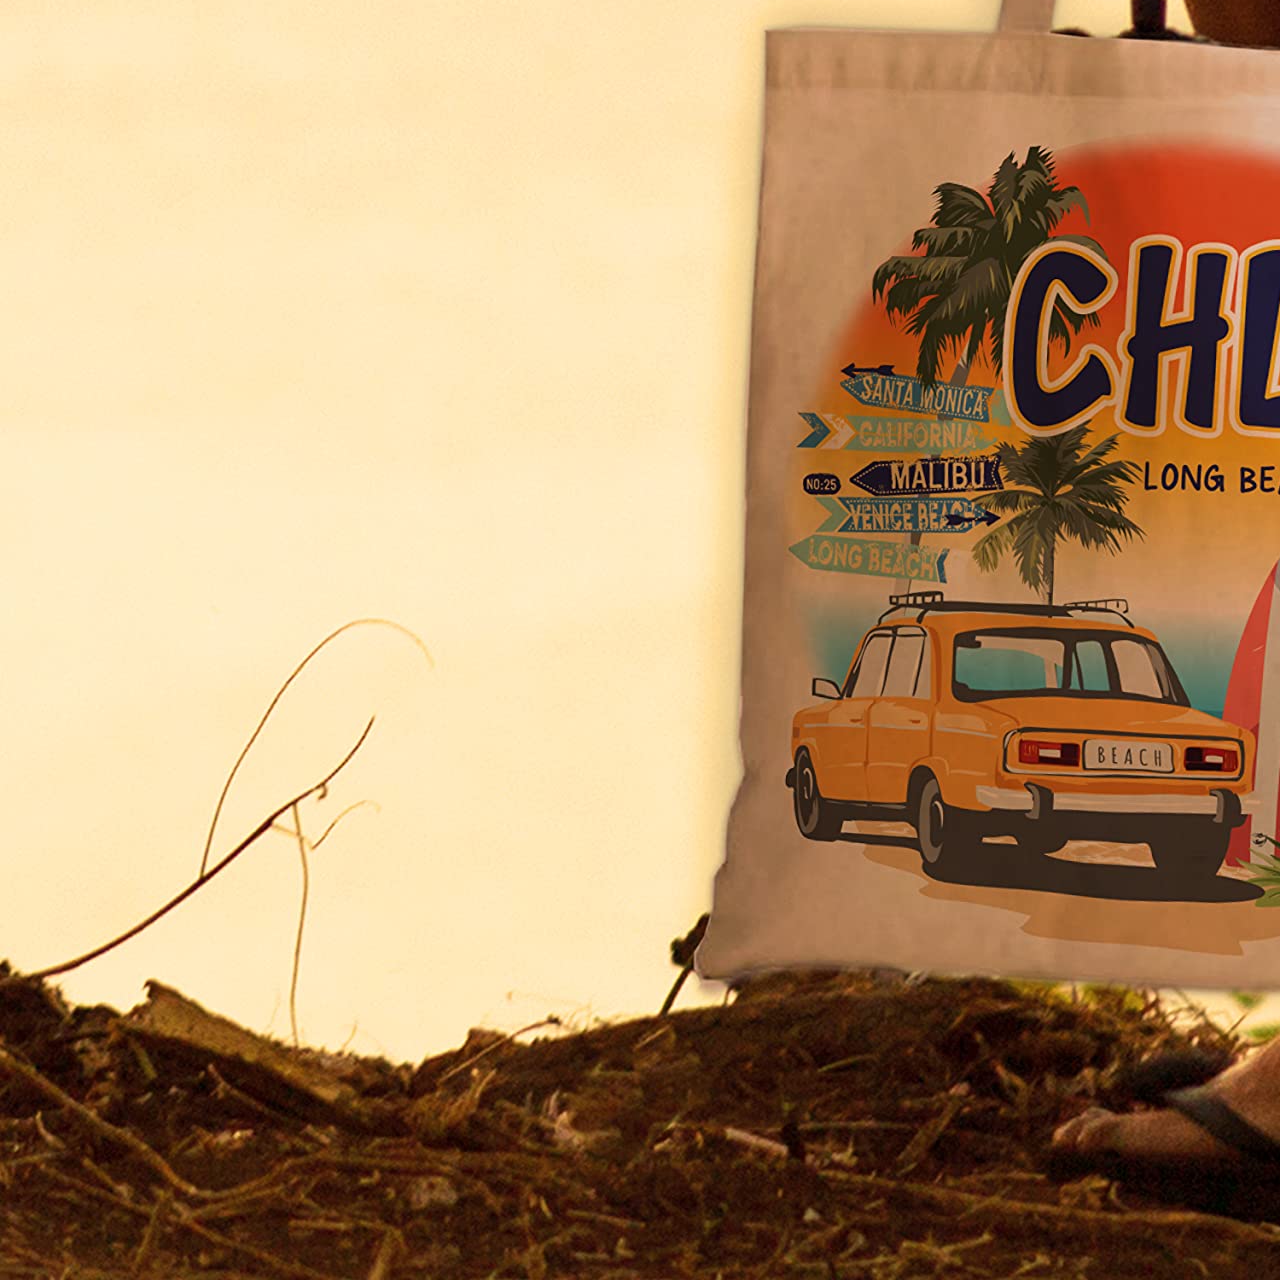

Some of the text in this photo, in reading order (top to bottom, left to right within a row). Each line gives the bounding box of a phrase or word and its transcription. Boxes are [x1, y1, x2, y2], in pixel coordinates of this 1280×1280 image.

[862, 376, 984, 416] SANTA MONICA
[859, 422, 977, 448] CALIFORNIA
[806, 478, 838, 491] NO:25
[890, 463, 985, 489] MALIBU
[1143, 461, 1226, 493] LONG
[849, 501, 976, 530] VENICE BEACH
[808, 539, 936, 579] LONG BEACH
[1097, 746, 1162, 766] BEACH
